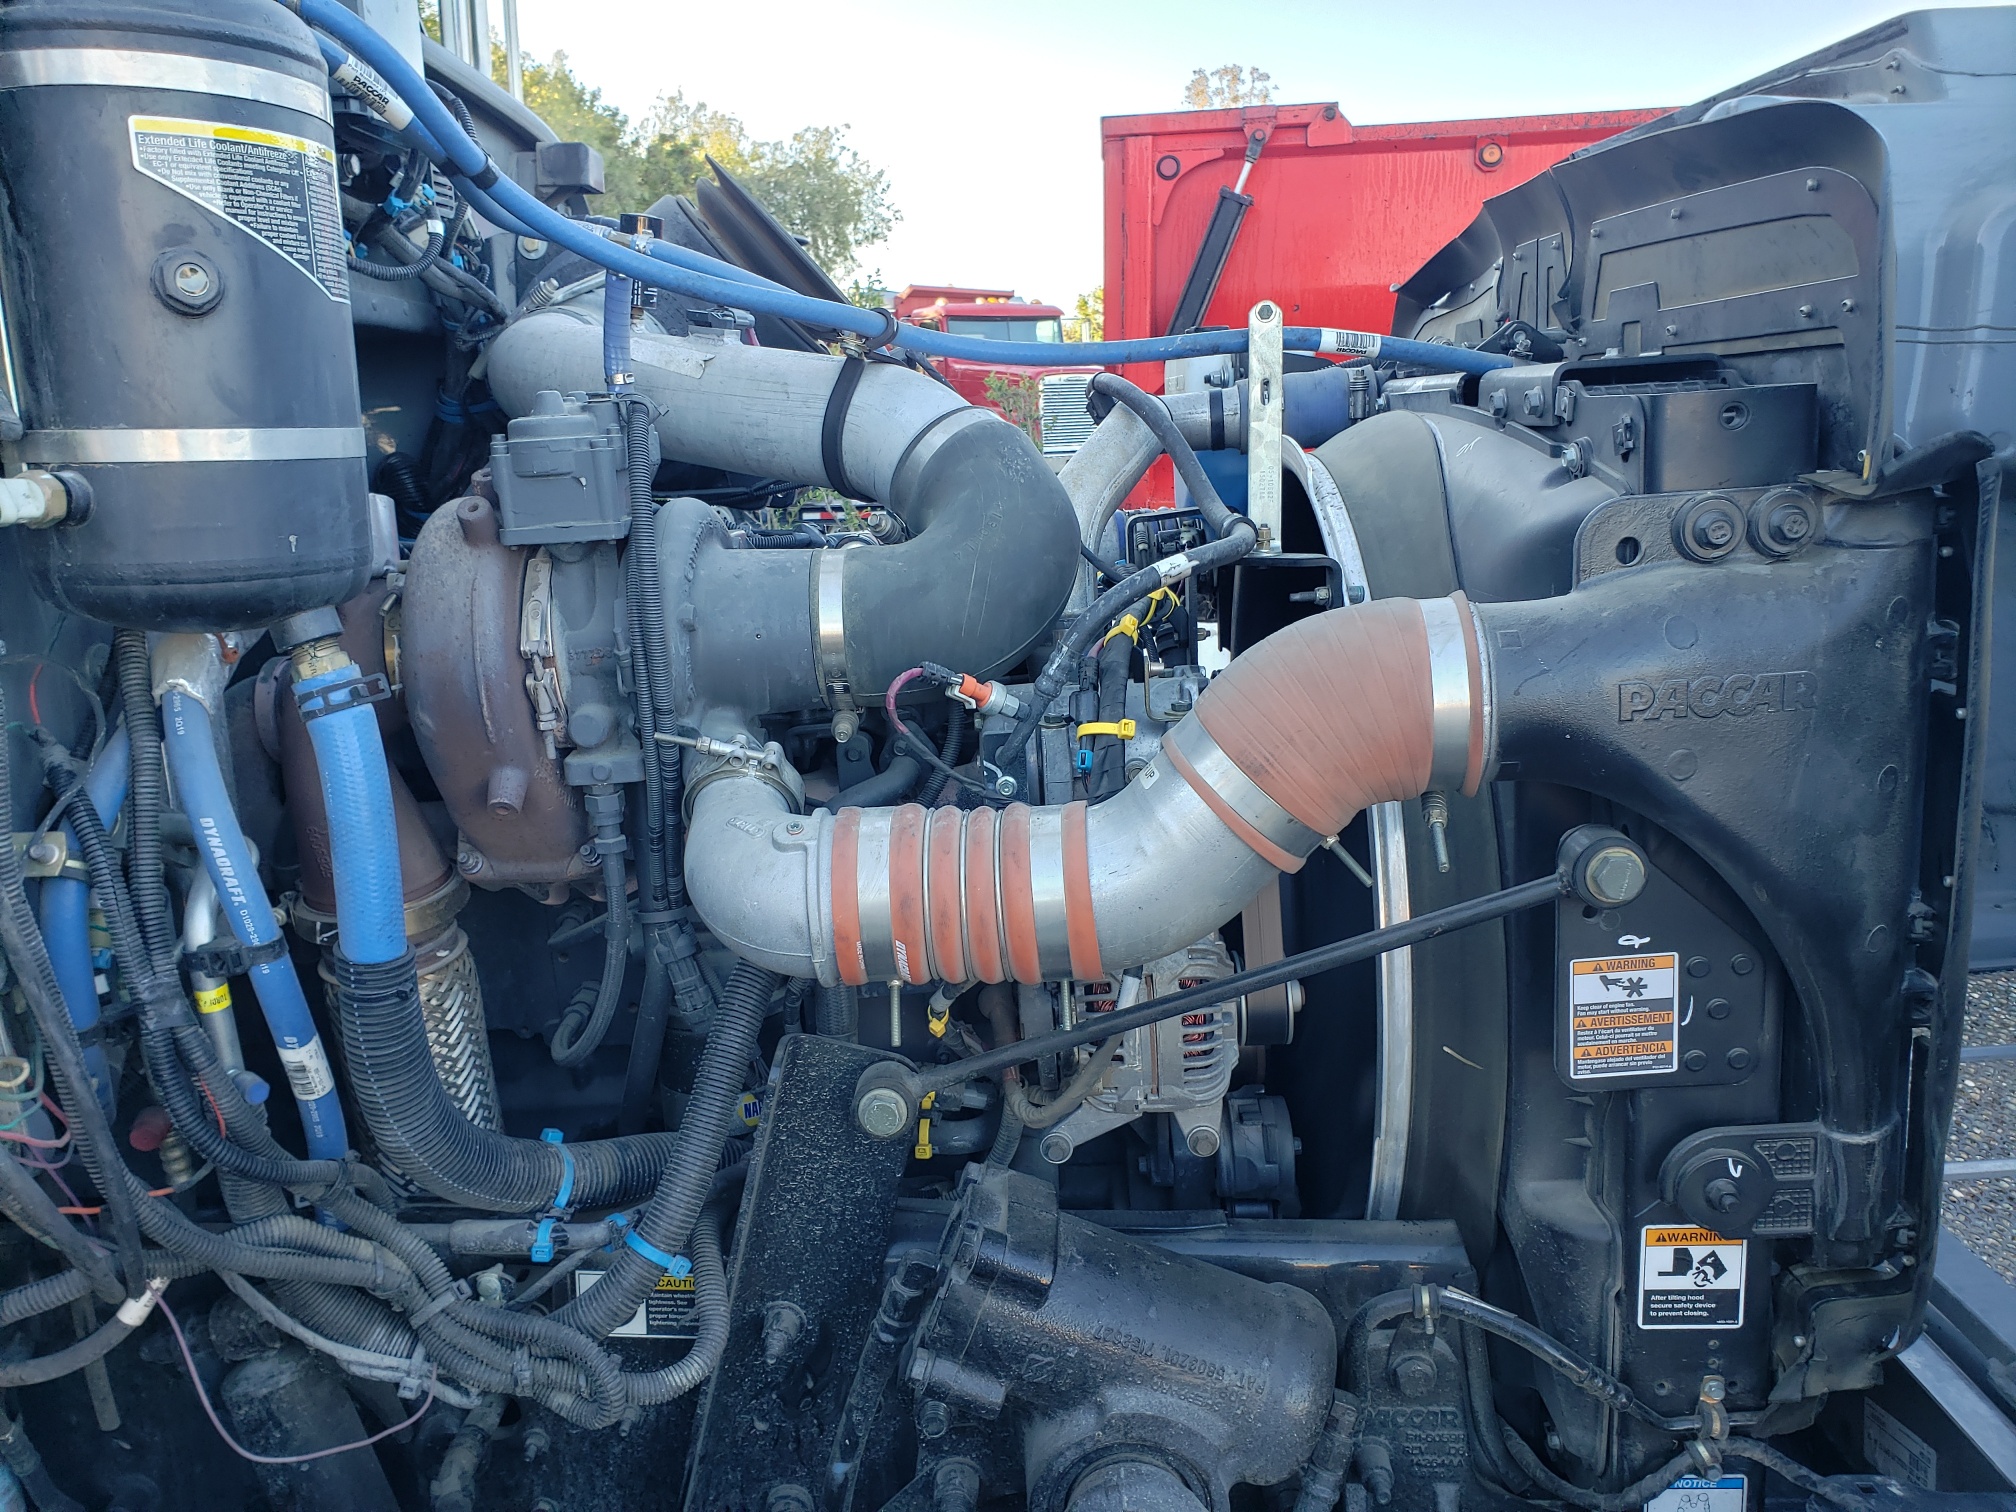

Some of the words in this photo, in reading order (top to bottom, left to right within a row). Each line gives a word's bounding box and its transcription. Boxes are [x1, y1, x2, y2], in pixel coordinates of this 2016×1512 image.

[353, 75, 390, 105] PACCAR
[138, 134, 186, 147] Extended
[188, 138, 207, 148] Life
[210, 140, 287, 160] Coolant/Antifreeze
[173, 155, 202, 163] Extended
[1336, 347, 1367, 355] PACCAR
[1618, 671, 1819, 721] PACCAR
[240, 908, 260, 946] D1029-29
[1606, 958, 1656, 971] WARNING
[1590, 1013, 1672, 1027] AVERTISSEMENT
[1595, 1043, 1666, 1056] ADVERTENCIA
[1667, 1232, 1723, 1242] WARNIN
[658, 1280, 696, 1288] CAUTI
[1674, 1480, 1718, 1488] NOTICE
